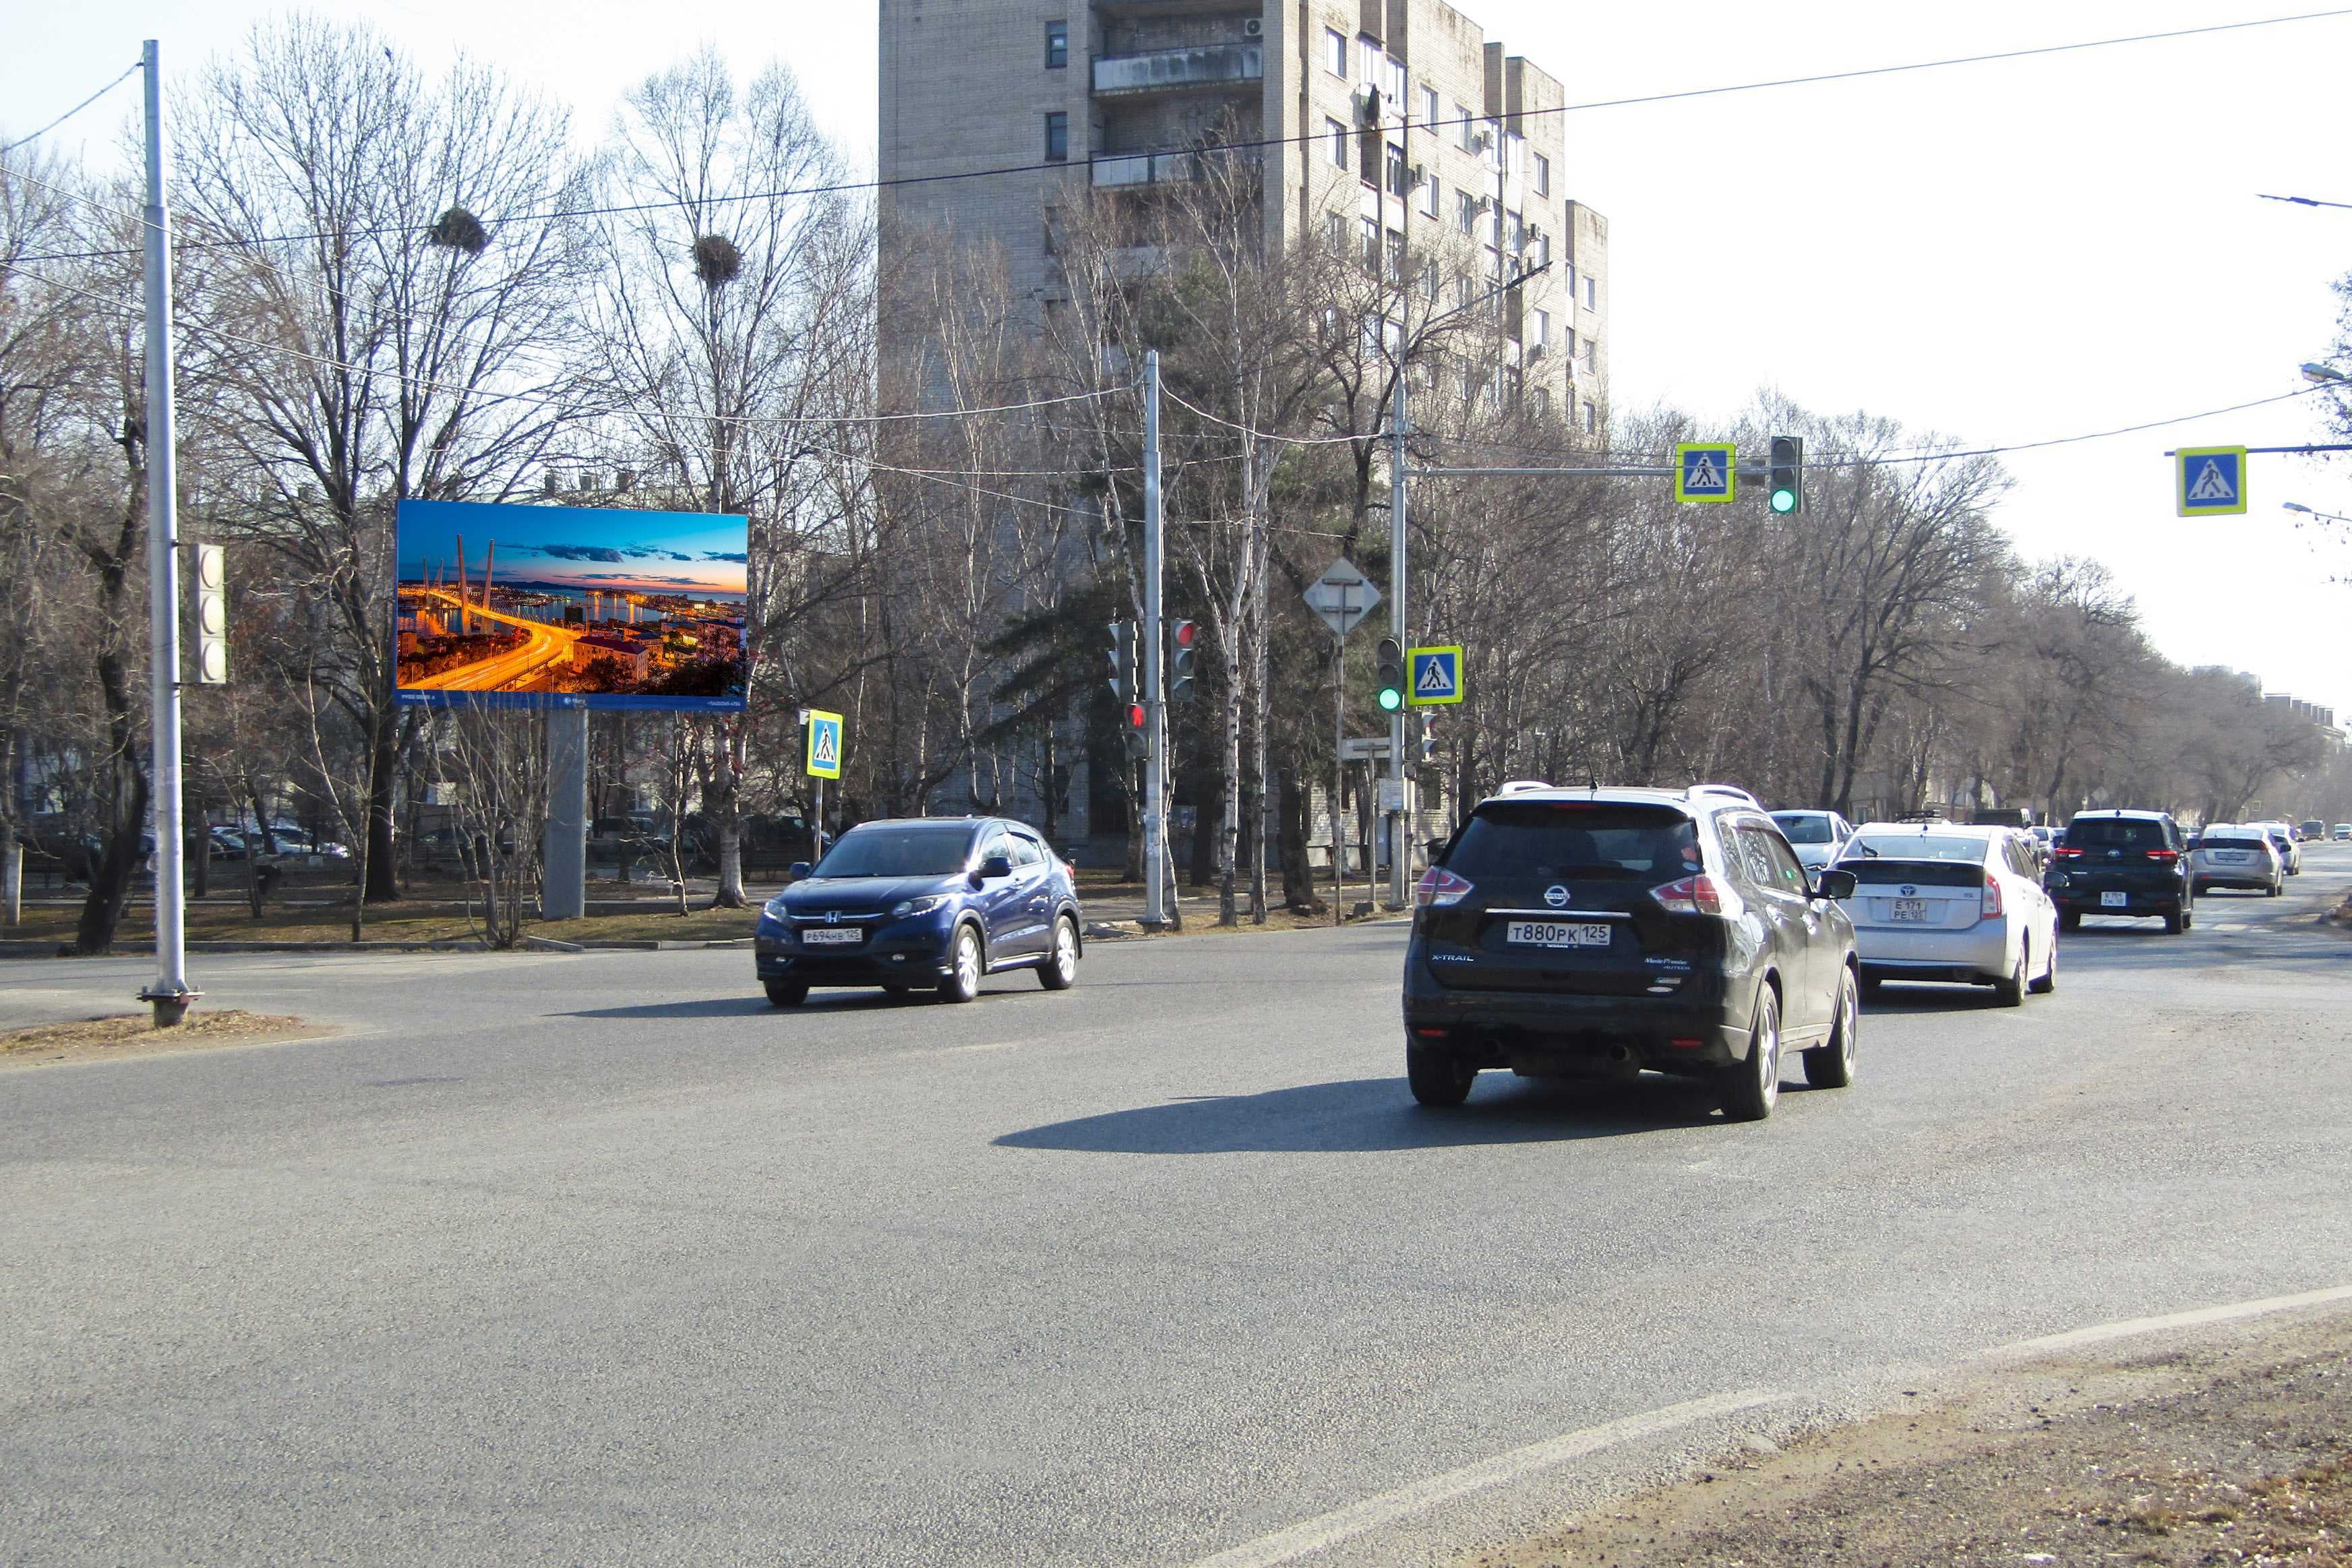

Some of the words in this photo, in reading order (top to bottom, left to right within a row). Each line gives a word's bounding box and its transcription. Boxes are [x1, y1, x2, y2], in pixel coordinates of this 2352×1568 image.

[1906, 901, 1921, 909] 171
[846, 929, 860, 938] 125
[1581, 926, 1607, 938] 125
